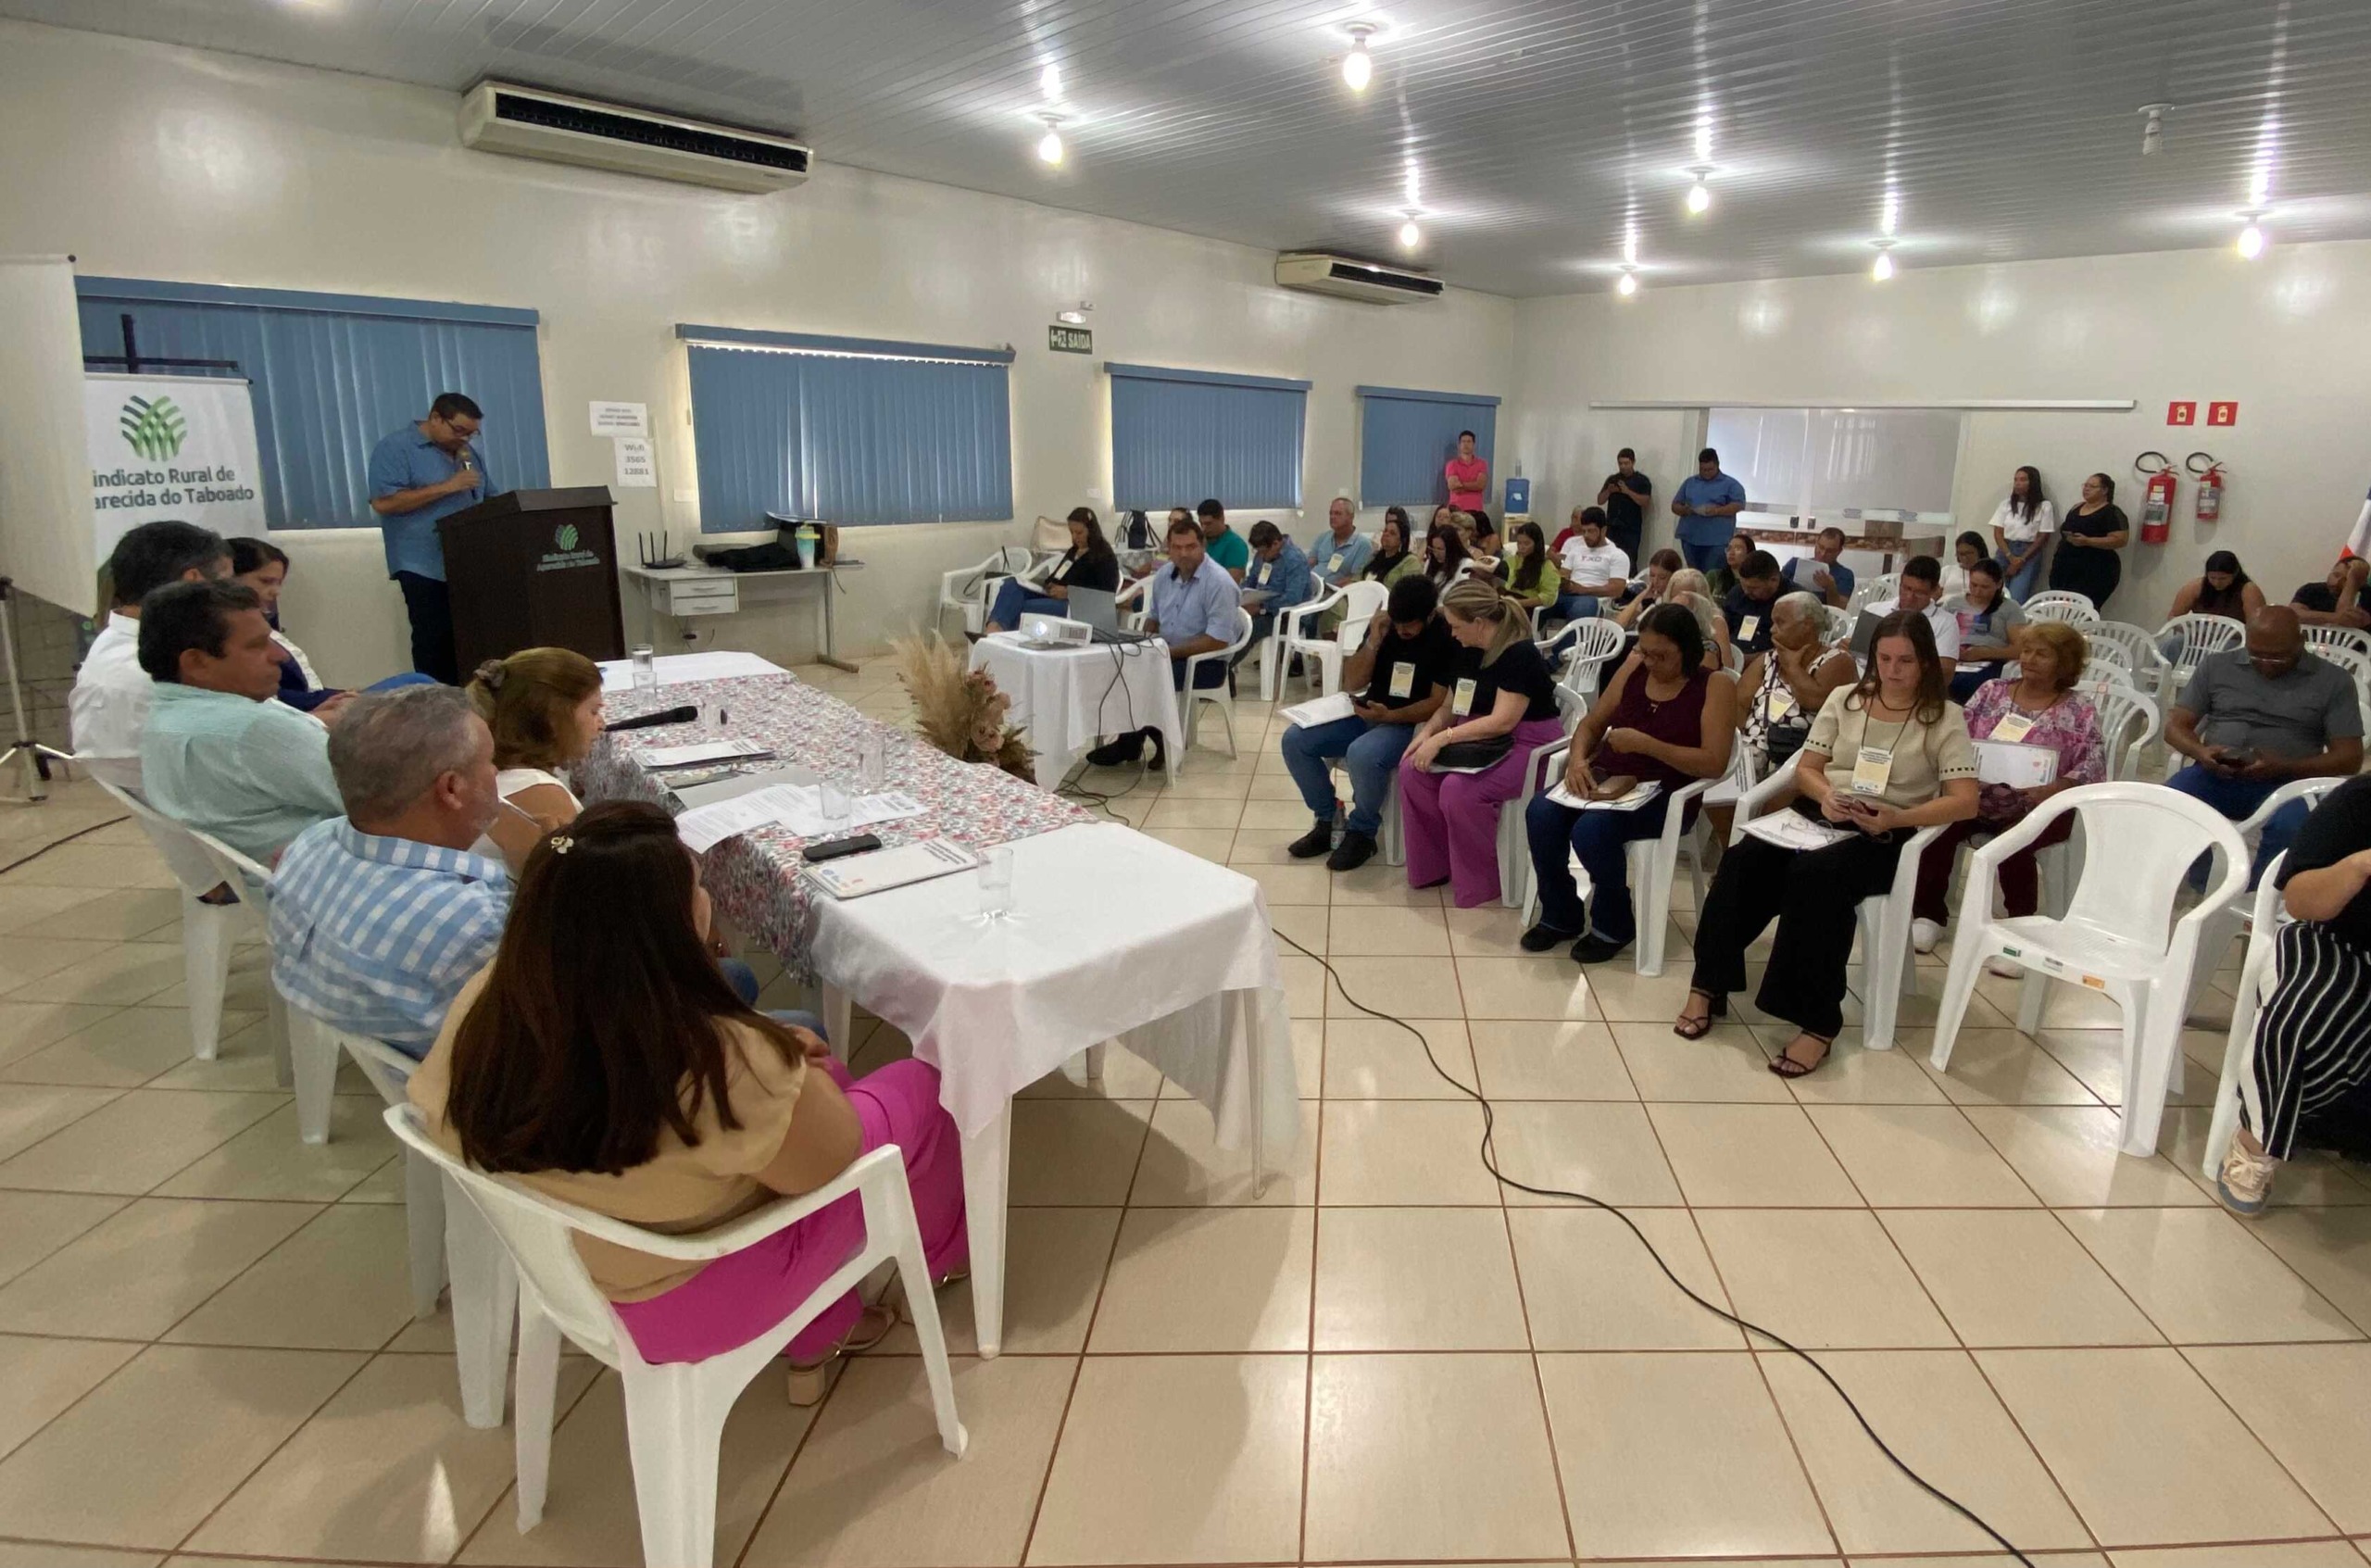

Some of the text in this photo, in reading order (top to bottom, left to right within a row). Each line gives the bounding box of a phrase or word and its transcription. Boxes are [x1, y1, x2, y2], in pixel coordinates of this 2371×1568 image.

[93, 465, 235, 487] indicato Rural de
[94, 484, 255, 509] arecida do Taboado
